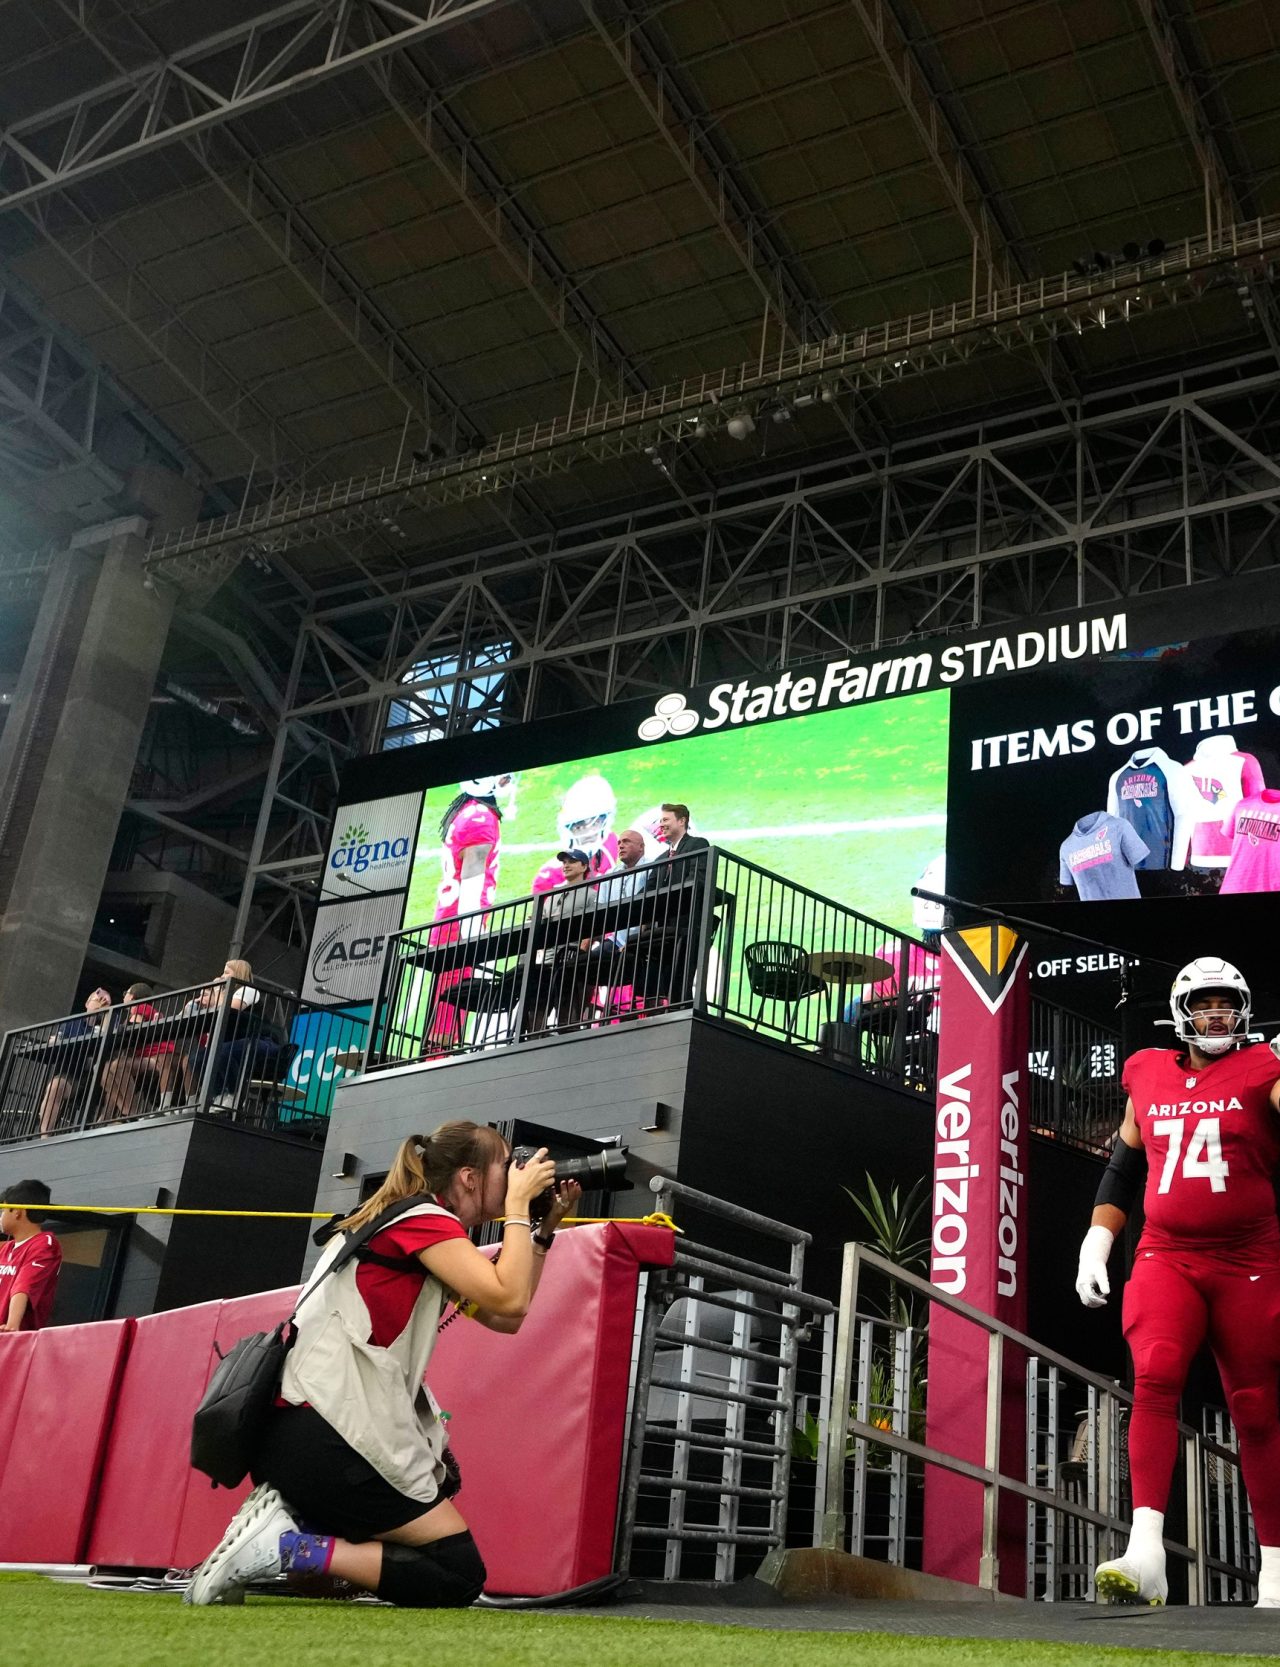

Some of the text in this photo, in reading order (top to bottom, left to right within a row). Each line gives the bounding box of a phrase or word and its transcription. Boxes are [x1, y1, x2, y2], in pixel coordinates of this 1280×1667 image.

[939, 613, 1127, 683] STADIUM
[970, 719, 1096, 771] ITEMS
[1106, 706, 1163, 746] OF
[1172, 689, 1258, 734] THE
[330, 836, 410, 874] cigna
[1036, 958, 1072, 978] OFF
[1146, 1096, 1244, 1118] ARIZONA
[932, 1063, 980, 1296] verizon
[997, 1070, 1024, 1297] verizon
[1152, 1117, 1230, 1195] 74
